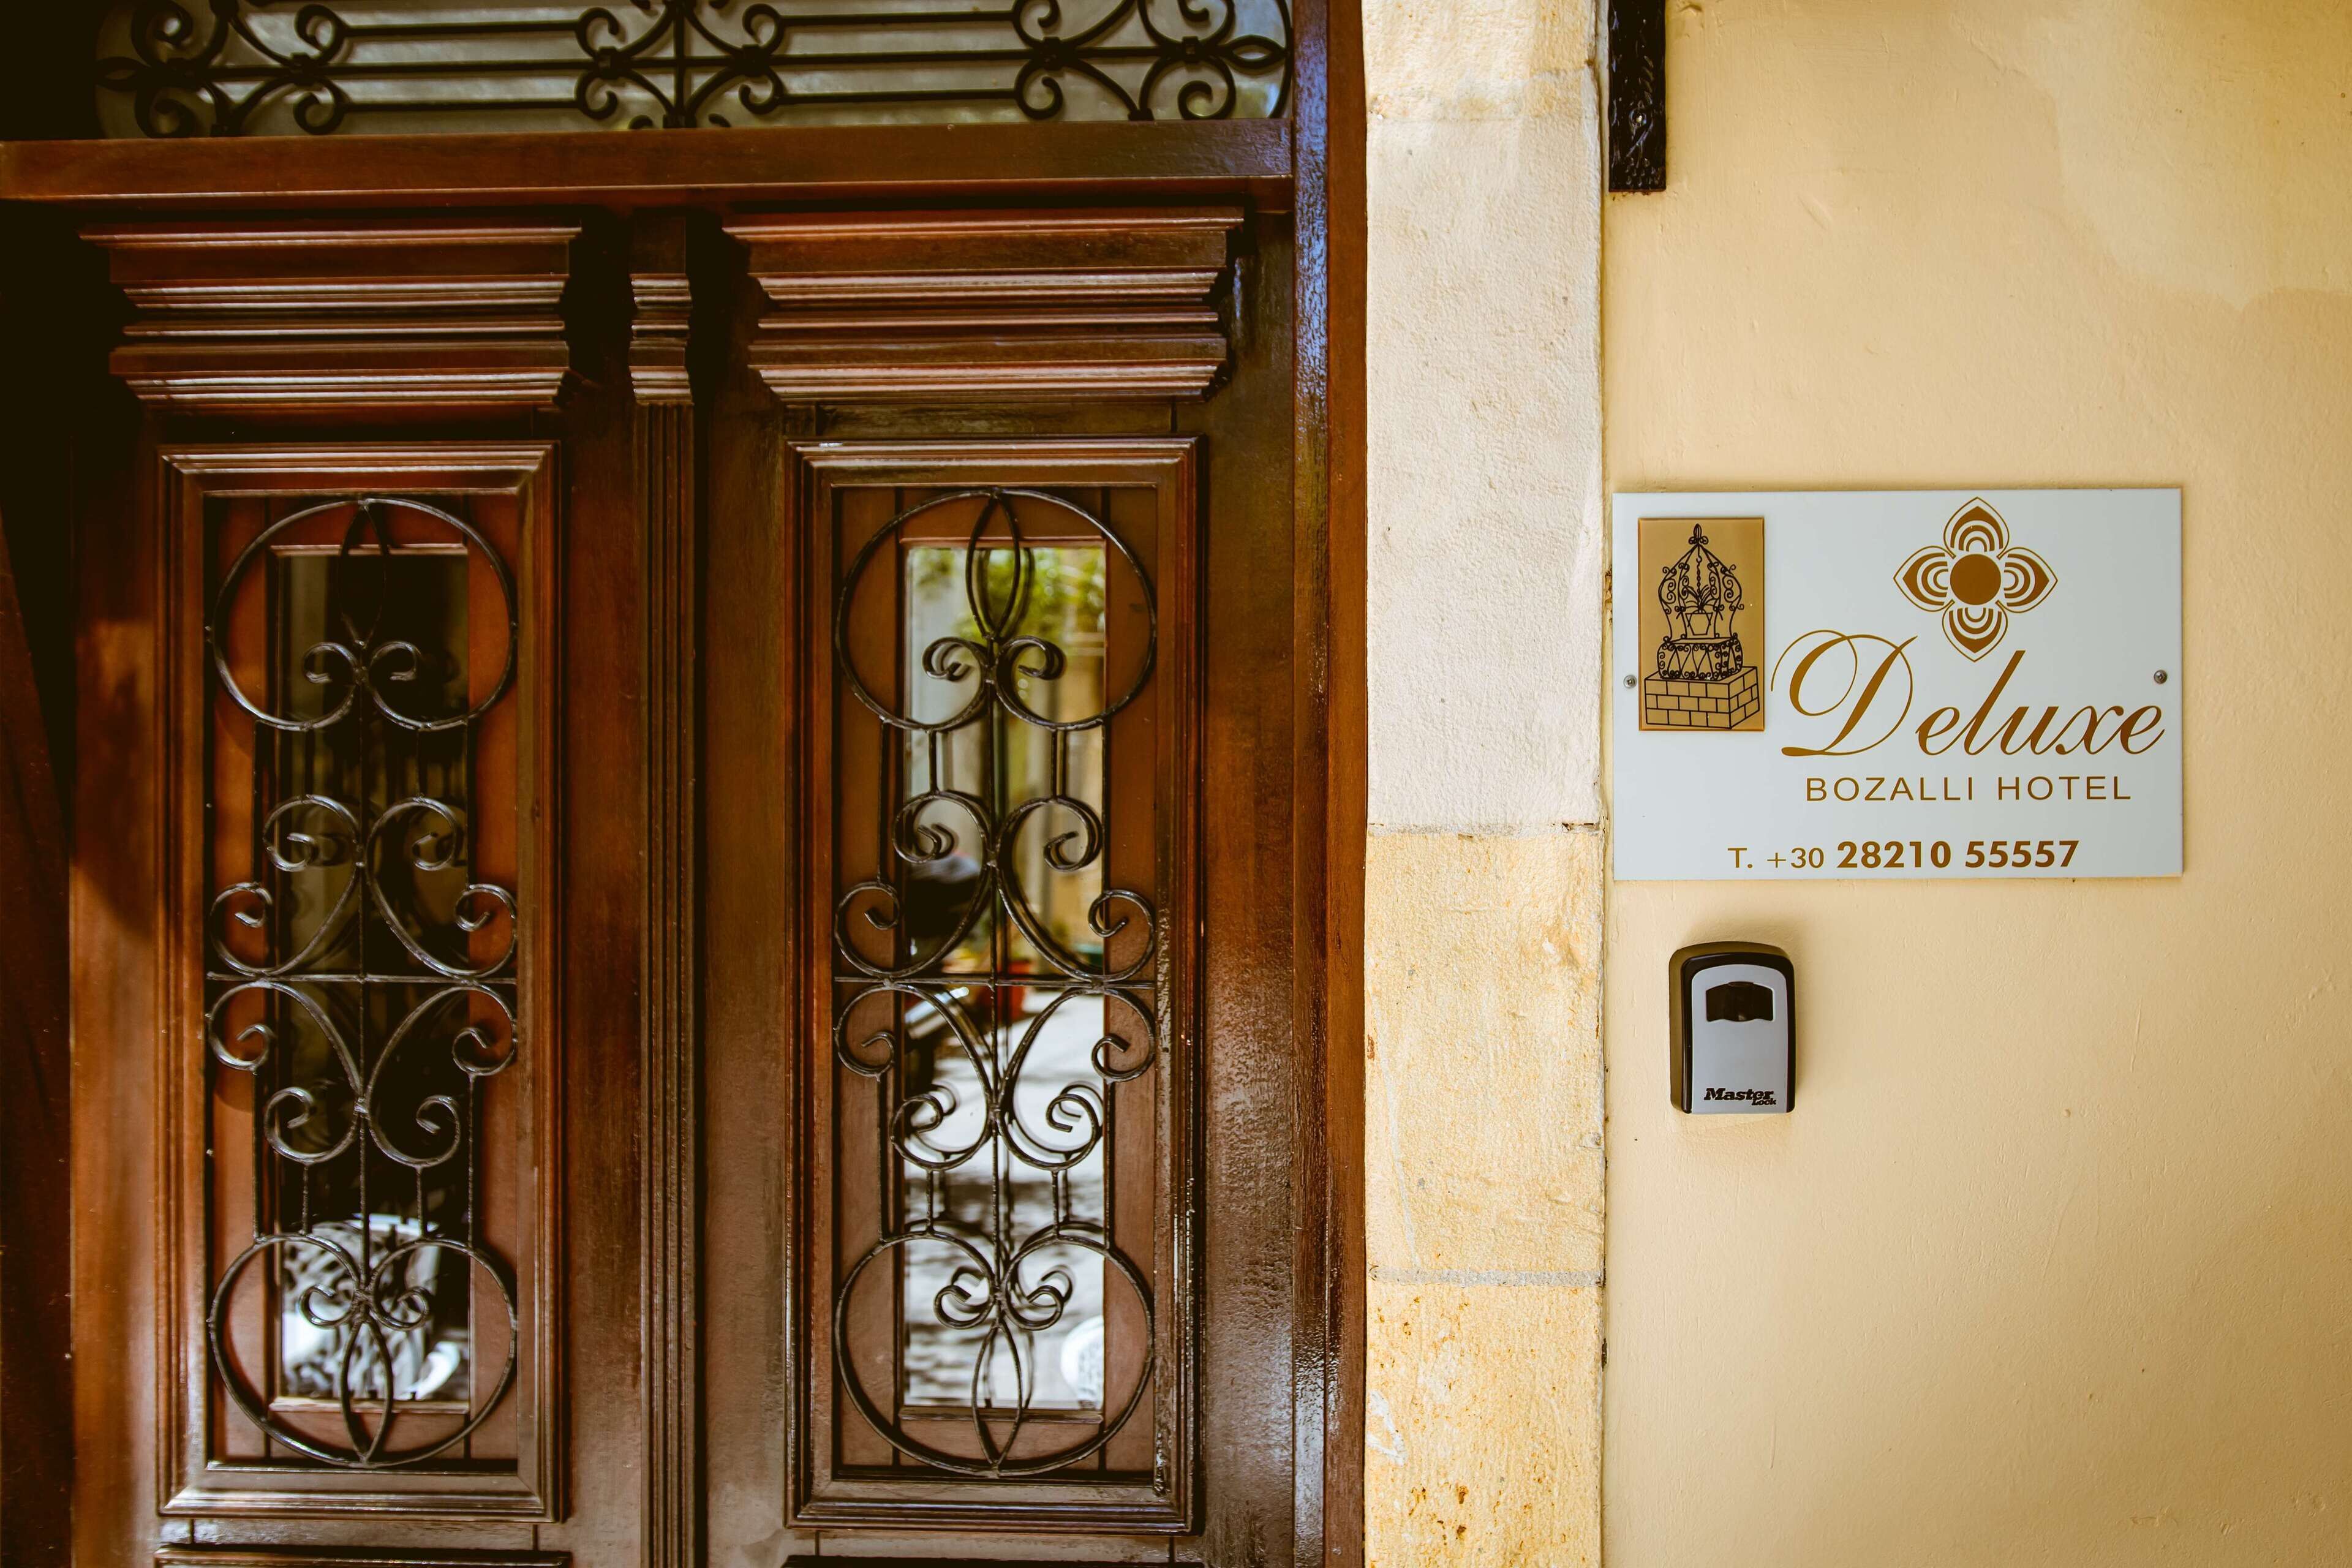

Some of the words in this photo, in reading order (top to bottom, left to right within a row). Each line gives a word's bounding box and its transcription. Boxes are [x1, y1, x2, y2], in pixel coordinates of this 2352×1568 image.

[1771, 629, 2166, 756] Deluxe
[1806, 777, 1973, 802] BOZALLI
[1997, 775, 2131, 801] HOTEL
[1727, 847, 1754, 869] T.
[1766, 847, 1824, 869] +30
[1837, 840, 1953, 869] 28210
[1965, 839, 2079, 868] 55557
[1704, 1088, 1774, 1101] Master
